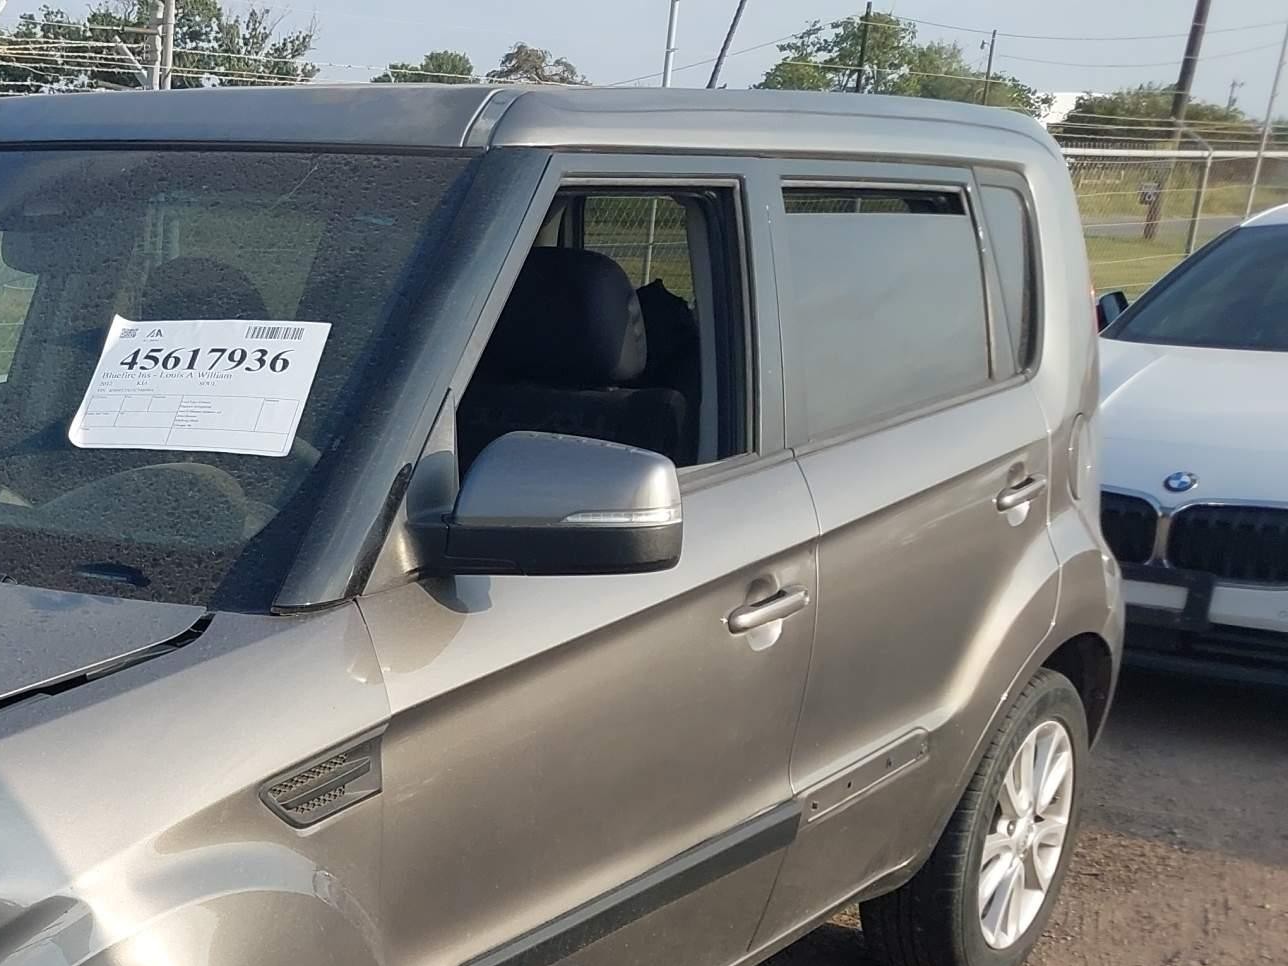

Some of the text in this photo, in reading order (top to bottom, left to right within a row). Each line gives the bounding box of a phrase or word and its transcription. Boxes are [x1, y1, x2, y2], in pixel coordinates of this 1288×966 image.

[120, 348, 296, 373] 45617936
[138, 371, 151, 379] Ins
[159, 371, 184, 379] Louis
[198, 371, 233, 380] William
